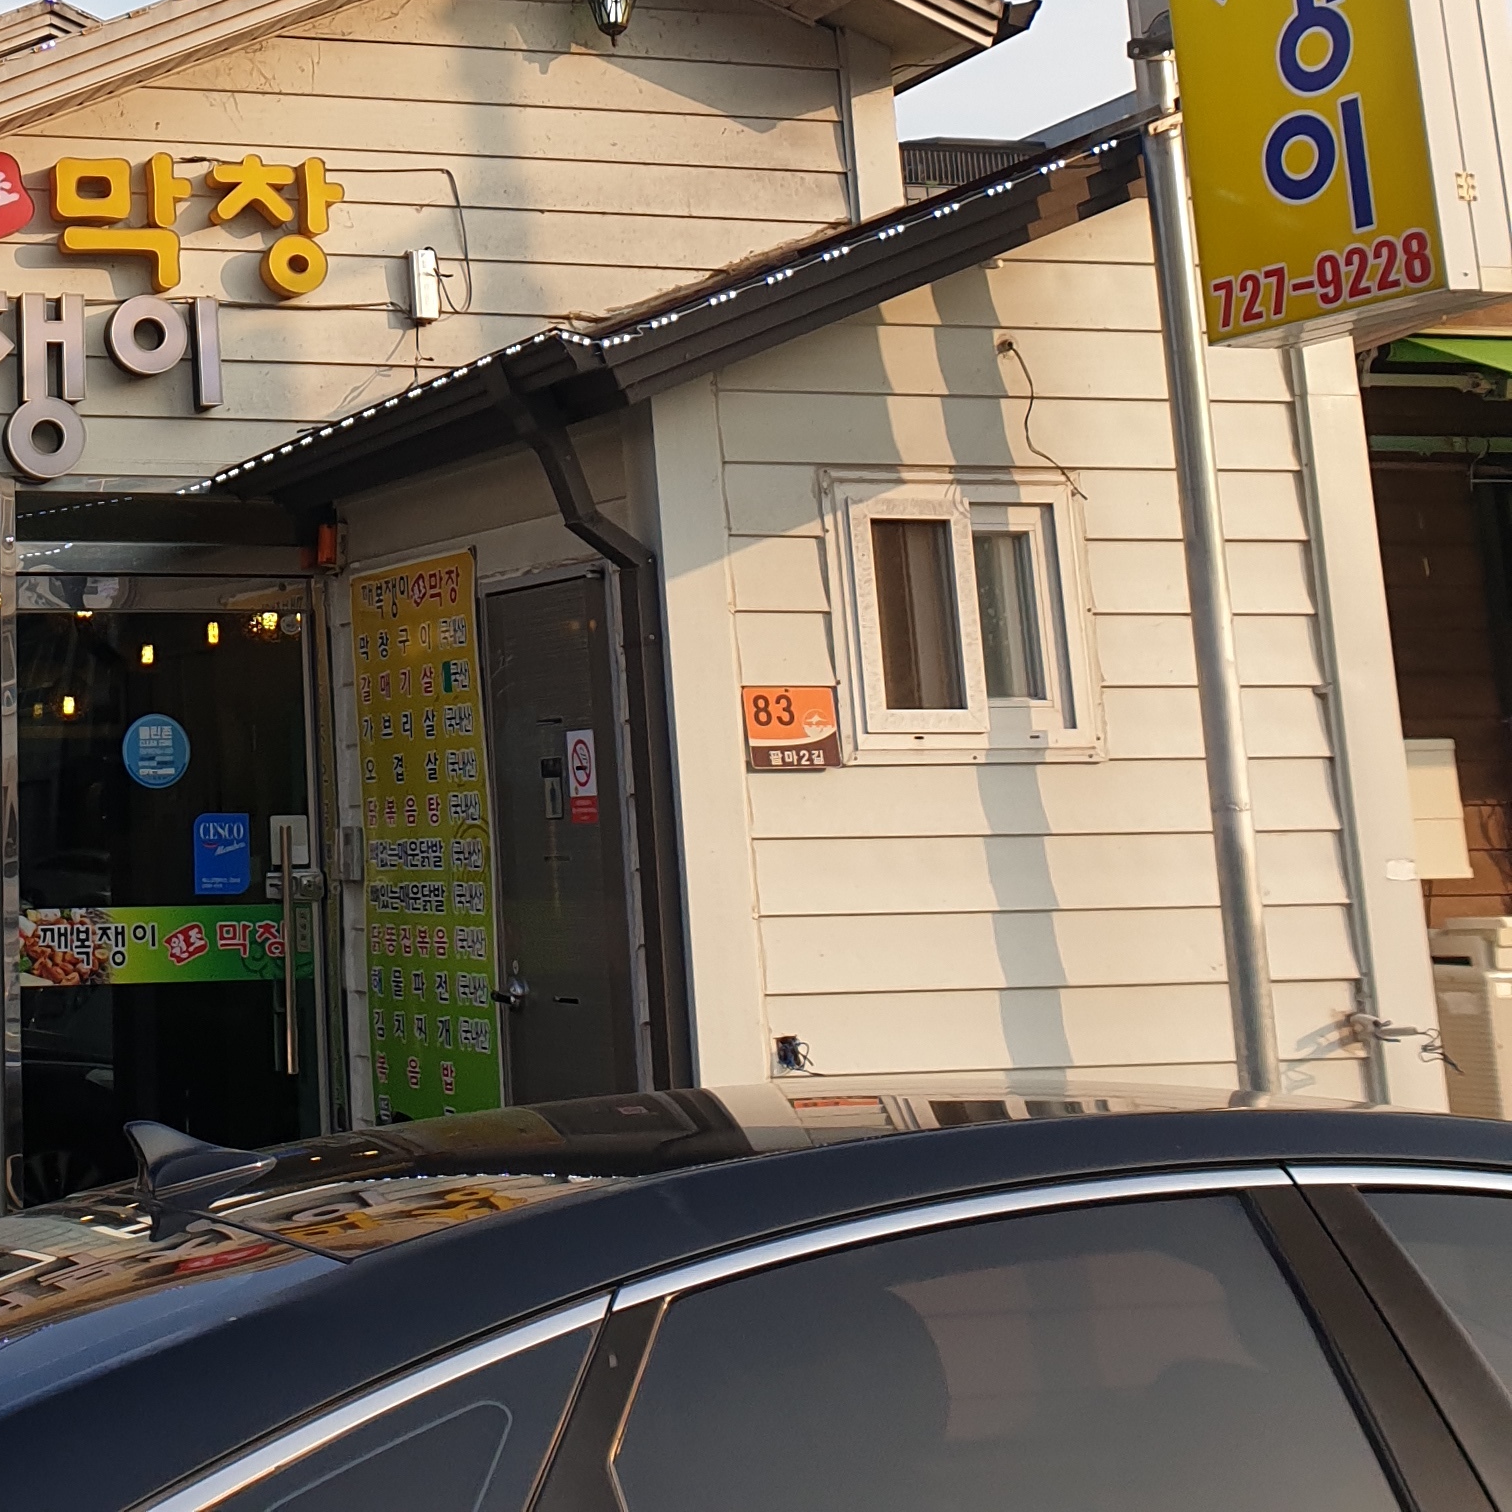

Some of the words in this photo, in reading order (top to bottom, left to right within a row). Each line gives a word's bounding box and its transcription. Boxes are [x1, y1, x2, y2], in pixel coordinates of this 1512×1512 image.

[49, 152, 345, 299] 막창
[1212, 230, 1433, 331] 727-9228
[752, 693, 796, 727] 83
[769, 749, 825, 766] 팔마2길
[199, 822, 245, 840] CESCO
[369, 839, 444, 869] 없는매운닭발
[370, 883, 446, 912] 있는매운닭발
[39, 924, 158, 968] 깨복쟁이
[169, 927, 202, 959] 원조
[217, 922, 285, 958] 막창
